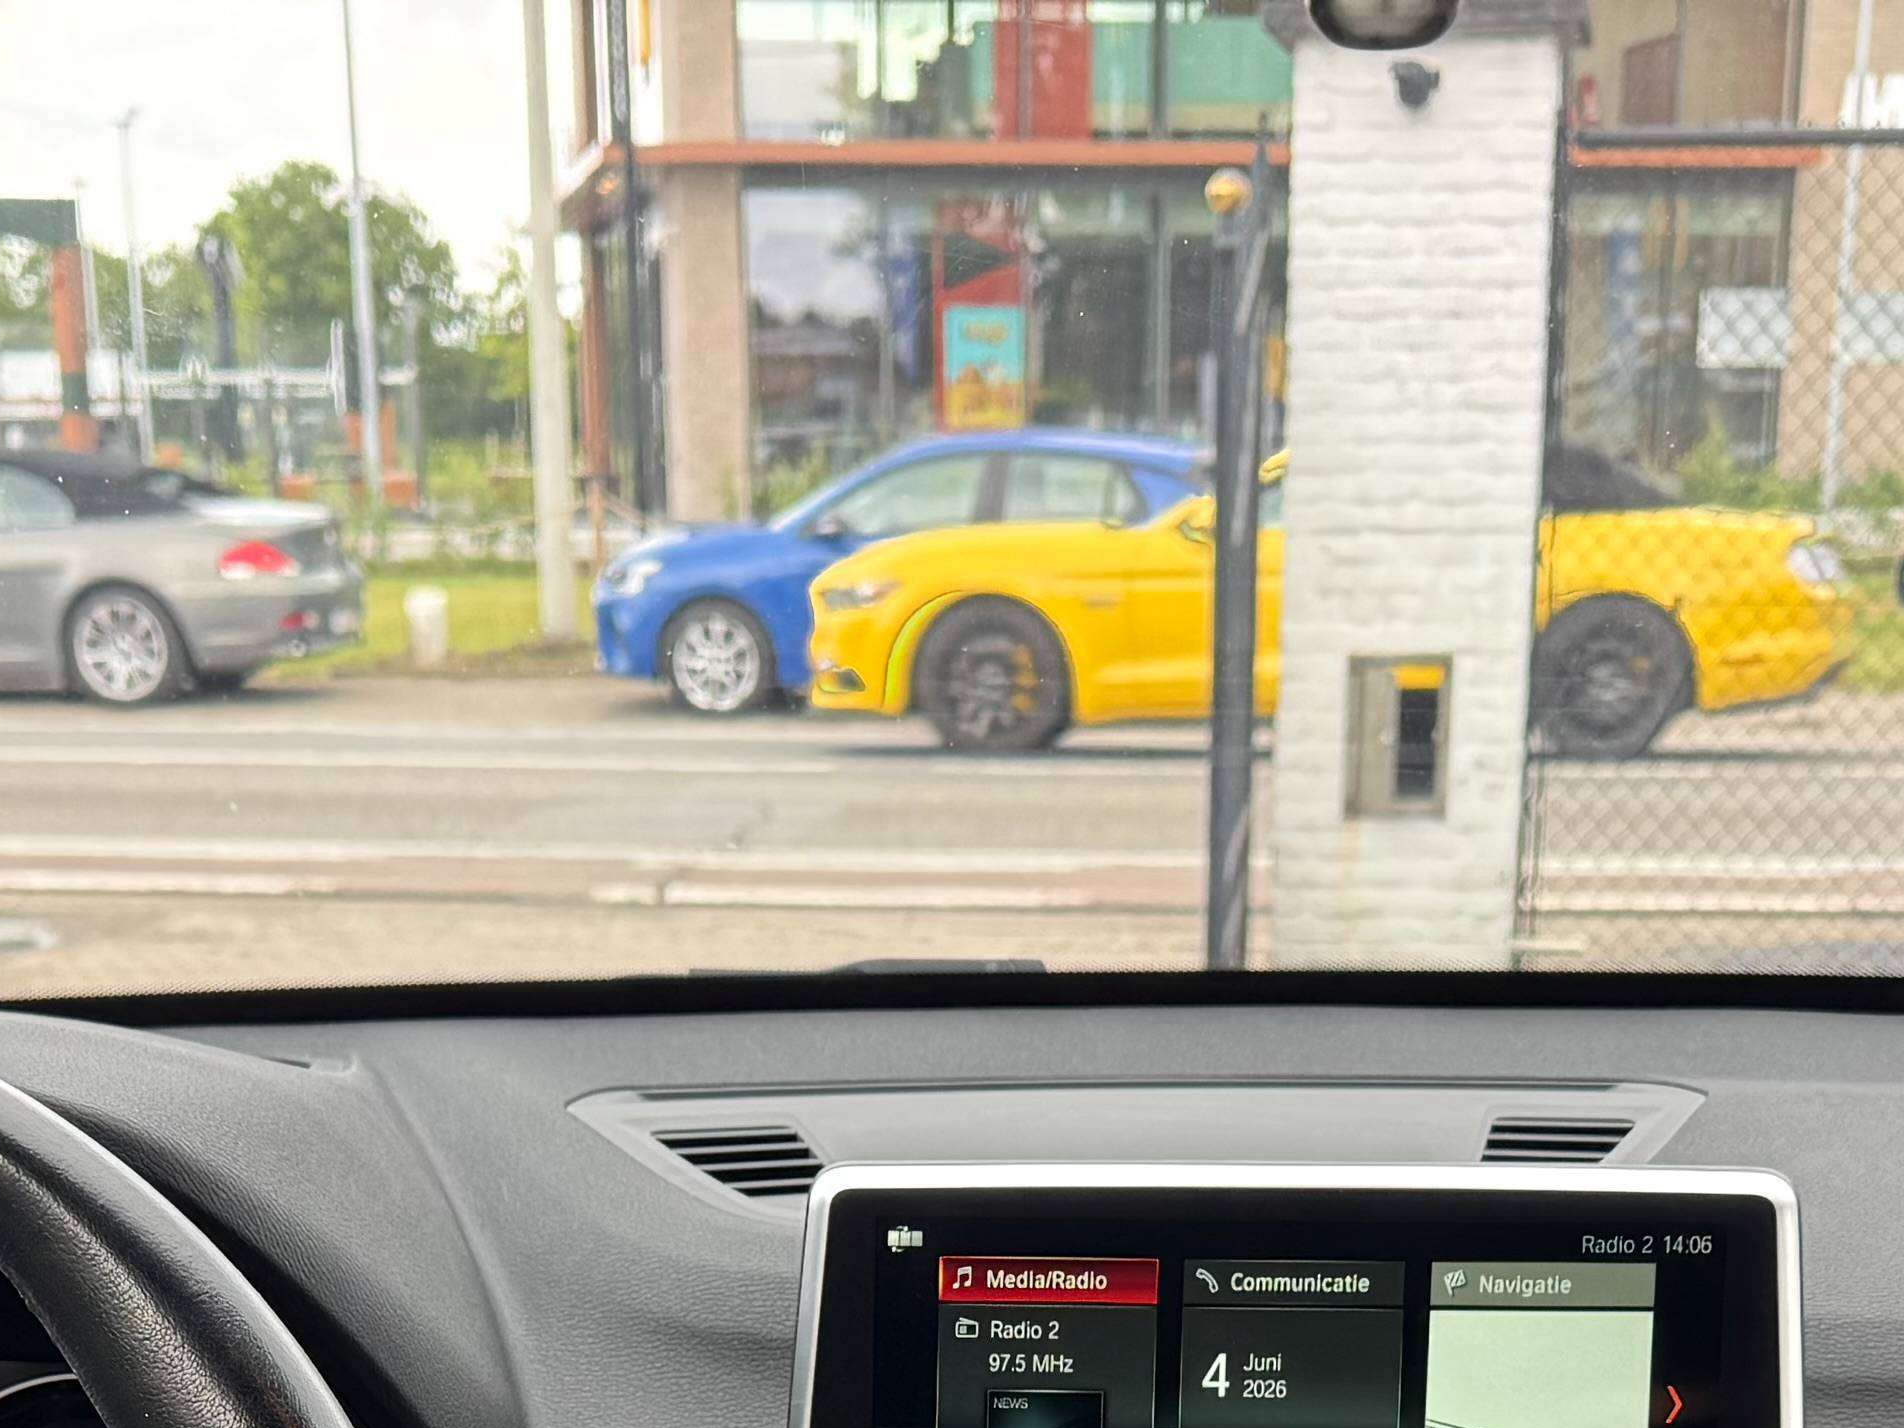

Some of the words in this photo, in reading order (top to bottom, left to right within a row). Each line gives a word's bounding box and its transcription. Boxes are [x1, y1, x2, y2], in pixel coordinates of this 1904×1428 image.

[1582, 1235, 1635, 1253] Radio
[1642, 1235, 1653, 1253] 2
[1664, 1236, 1712, 1254] 14:06
[986, 1269, 1108, 1290] Media/Radio
[1230, 1272, 1370, 1293] Communicatie
[1479, 1275, 1572, 1297] Navigatie
[990, 1320, 1042, 1340] Radio
[1048, 1321, 1060, 1340] 2
[988, 1353, 1026, 1373] 97.5
[1032, 1354, 1074, 1374] MHz
[1243, 1353, 1282, 1372] Juni
[1201, 1352, 1230, 1398] 4
[1242, 1379, 1287, 1399] 2026
[993, 1397, 1029, 1409] NEWS
